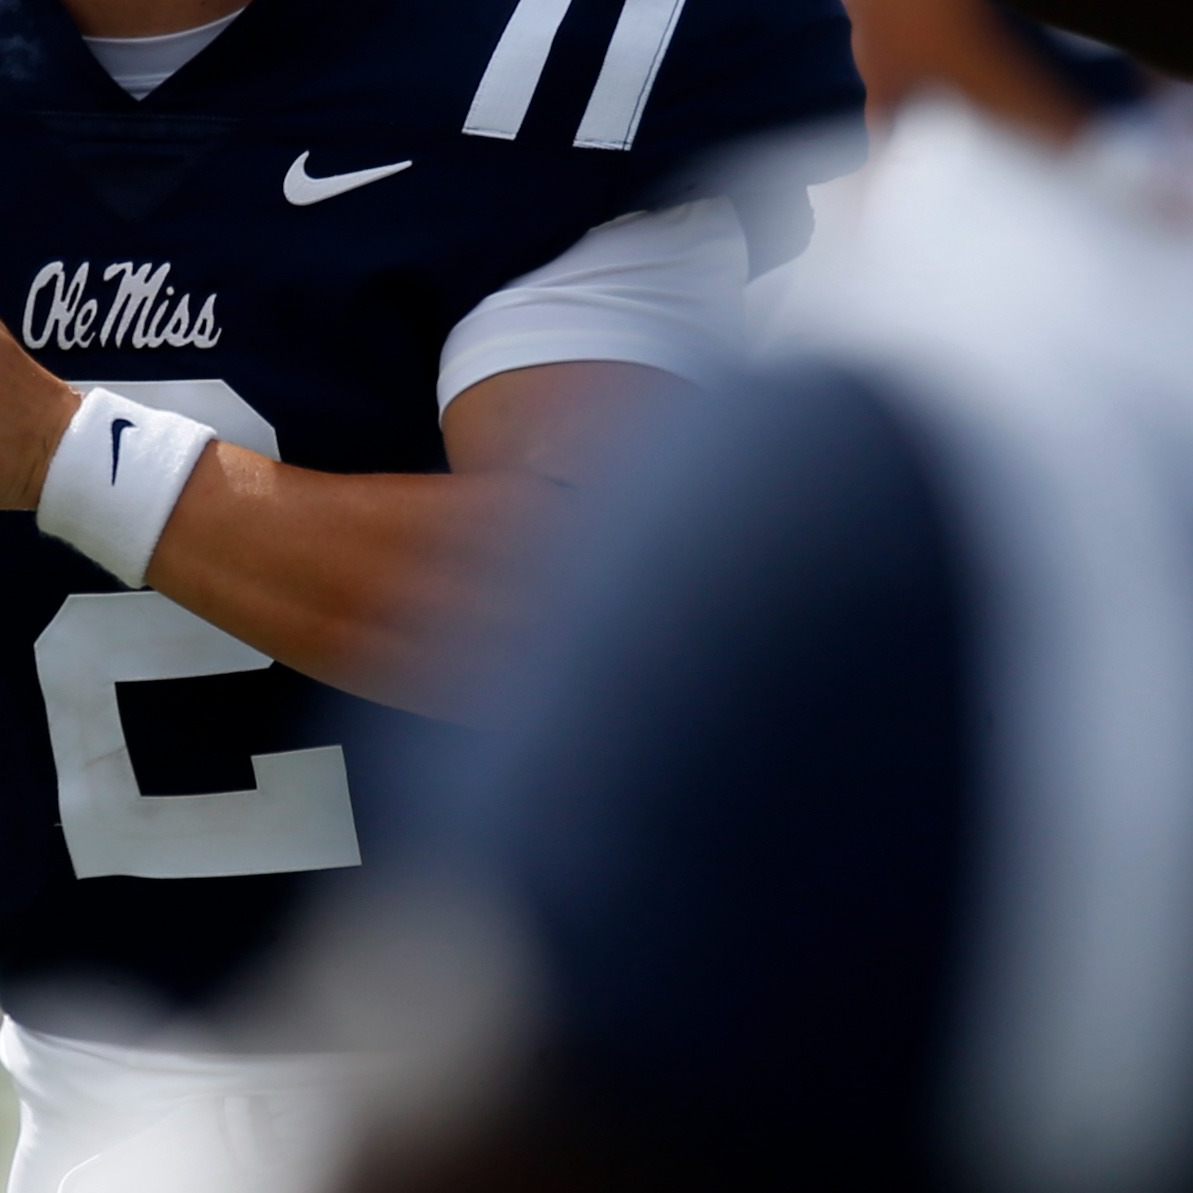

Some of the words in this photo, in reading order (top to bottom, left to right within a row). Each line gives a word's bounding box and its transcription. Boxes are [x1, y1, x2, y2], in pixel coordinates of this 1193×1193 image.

[22, 261, 98, 350] Ole
[100, 261, 222, 349] Miss
[34, 379, 362, 879] 2
